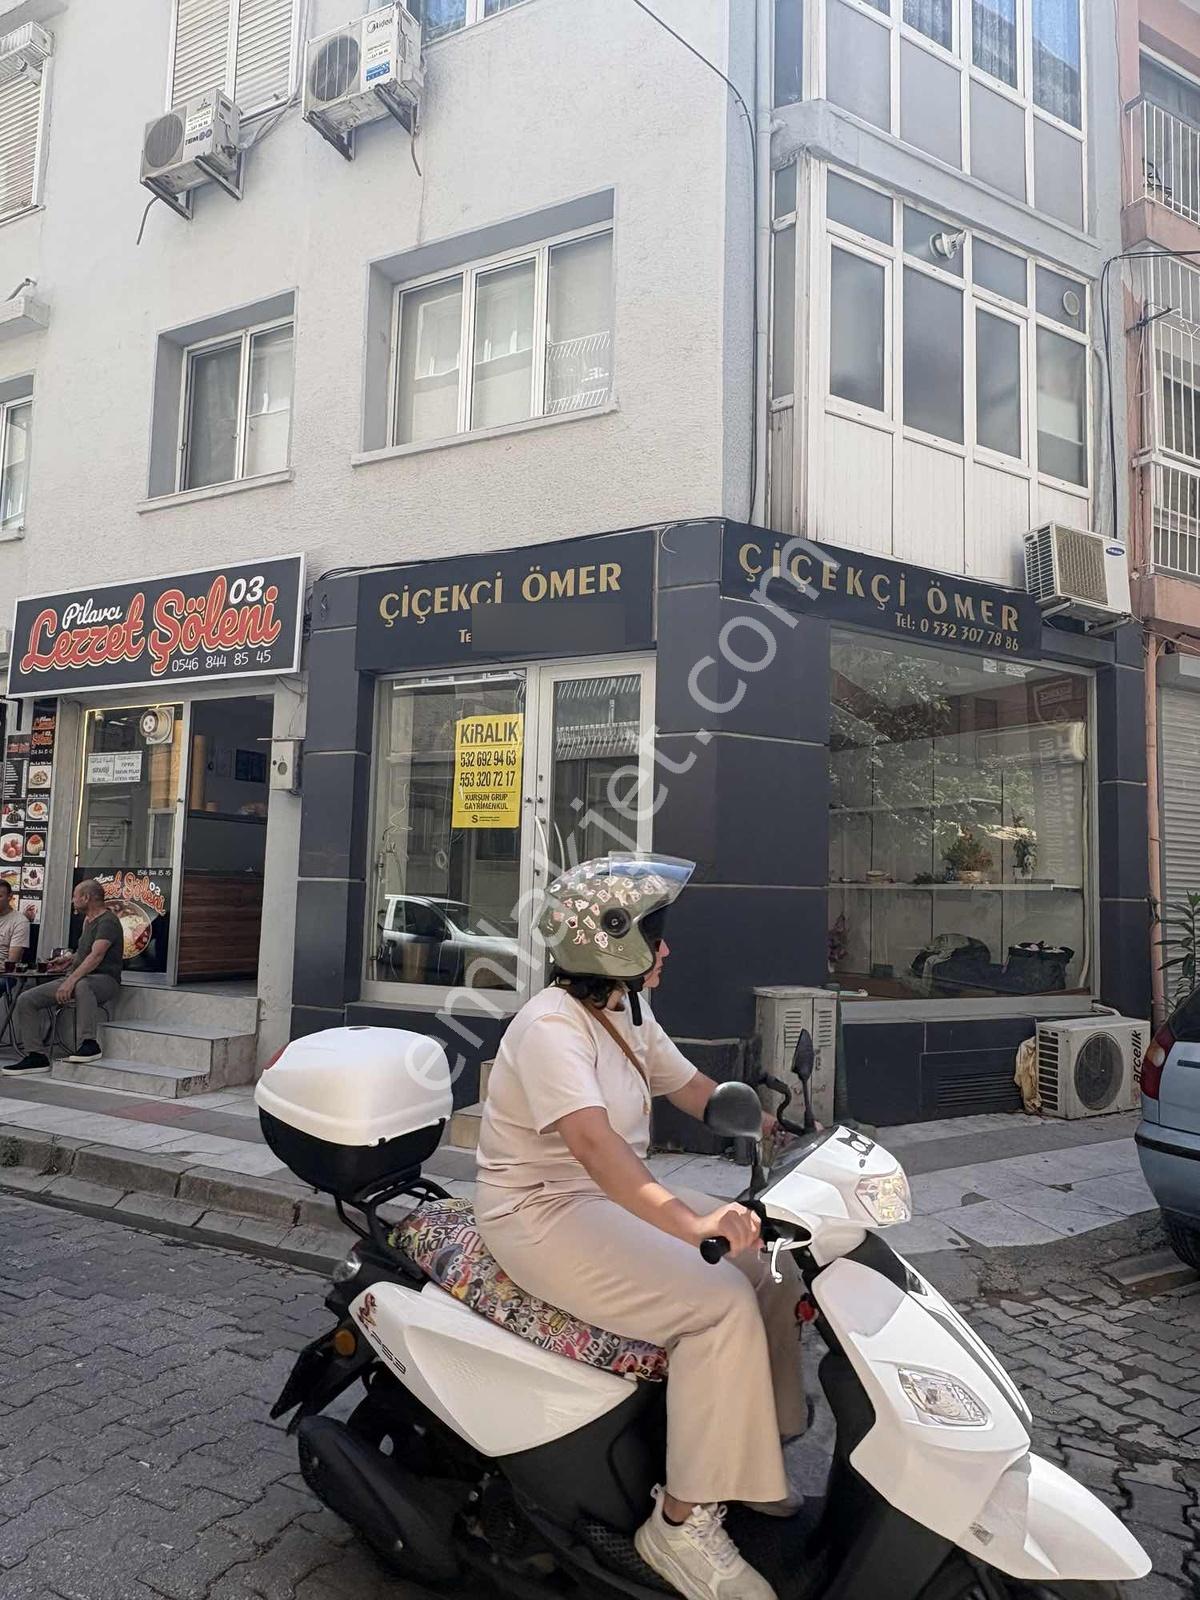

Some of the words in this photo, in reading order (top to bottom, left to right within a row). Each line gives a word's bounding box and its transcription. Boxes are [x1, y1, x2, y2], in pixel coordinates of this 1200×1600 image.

[229, 575, 265, 604] 03
[521, 562, 622, 602] ÖMER
[738, 542, 906, 611] ÇİÇEKÇİ
[927, 580, 1019, 632] ÖMER
[20, 592, 146, 675] Lezzet
[149, 574, 282, 676] Şöleni
[62, 598, 123, 630] Pilavcı
[920, 618, 929, 633] 0
[933, 621, 957, 639] 532
[961, 625, 985, 643] 307
[987, 630, 1002, 647] 78
[1005, 636, 1019, 651] 86
[171, 657, 199, 672] 0546
[205, 656, 227, 669] 844
[233, 652, 249, 666] 85
[256, 650, 272, 664] 45
[460, 751, 475, 768] 532
[477, 751, 492, 767] 692
[494, 750, 504, 767] 94
[506, 750, 516, 766] 63
[460, 771, 475, 788] 553
[476, 771, 492, 787] 320
[493, 771, 503, 787] 72
[506, 770, 516, 786] 17
[491, 793, 509, 801] GRUP
